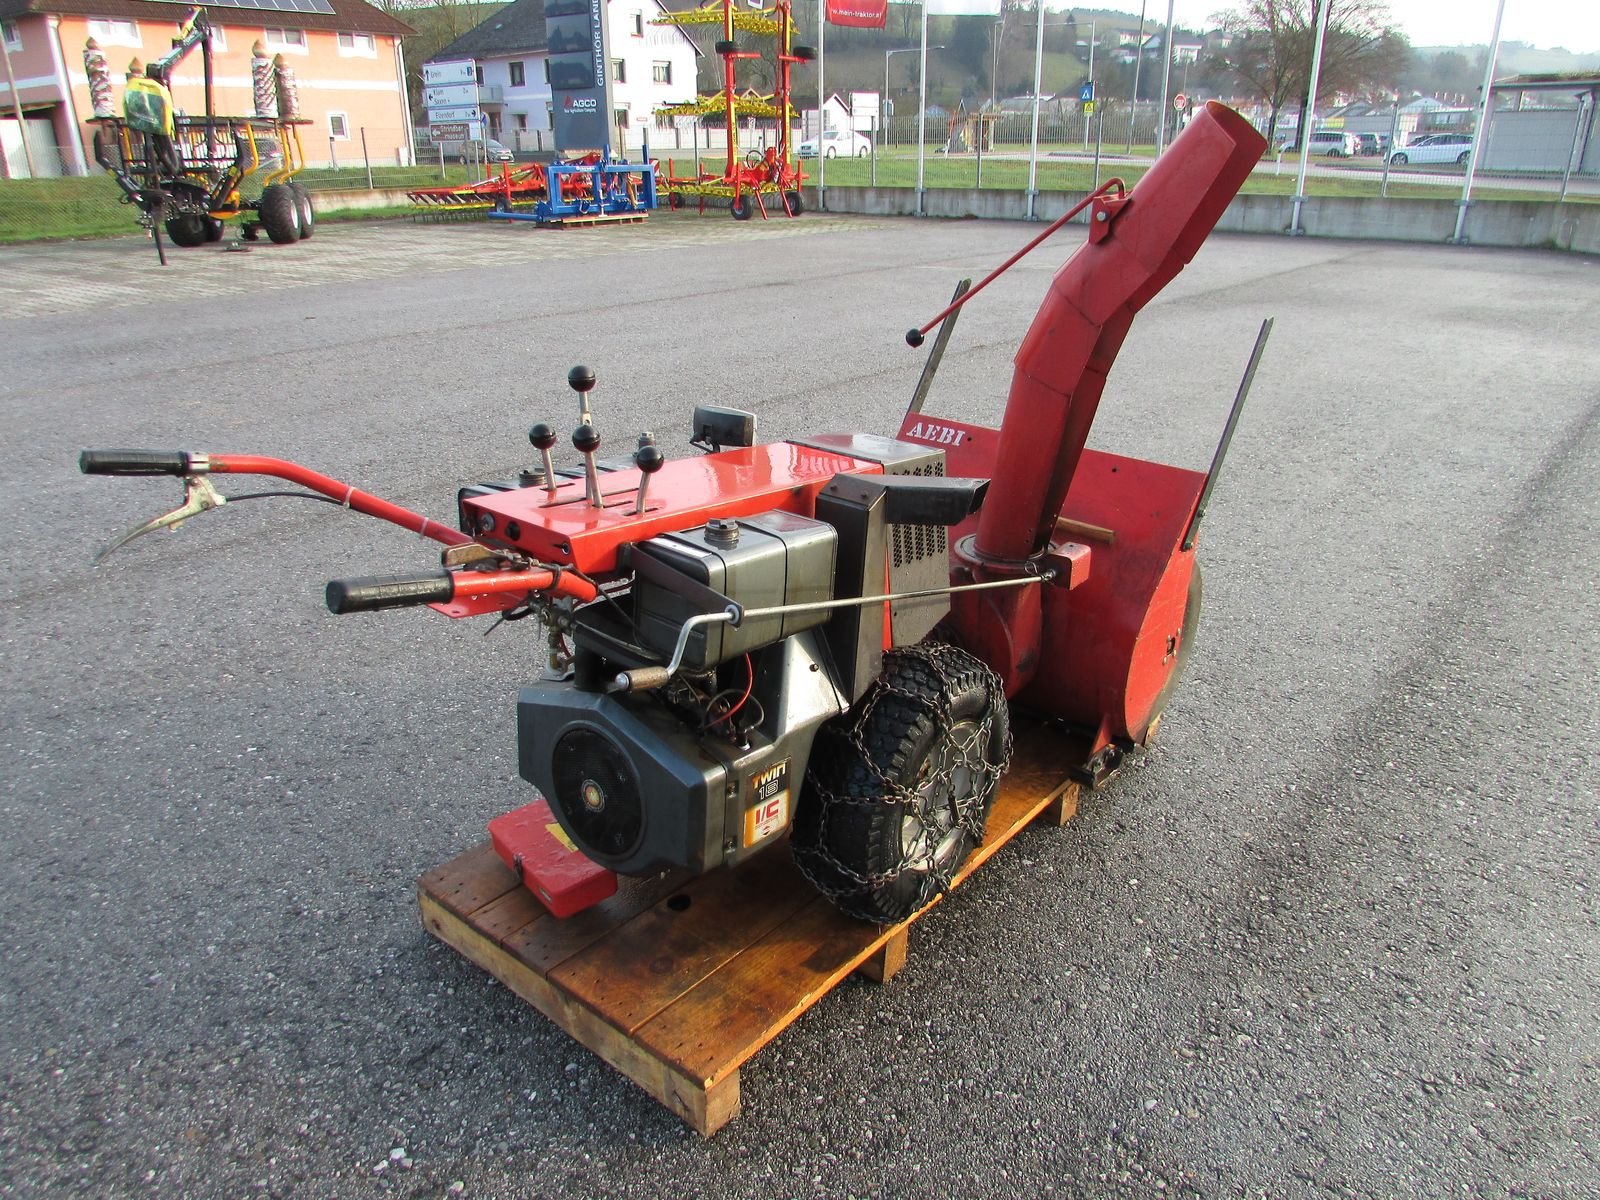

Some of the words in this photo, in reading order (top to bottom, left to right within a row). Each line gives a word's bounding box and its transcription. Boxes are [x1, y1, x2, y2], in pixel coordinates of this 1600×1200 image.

[594, 32, 604, 86] GINTHÖR
[573, 99, 597, 107] AGCO
[905, 422, 966, 446] AEBI
[752, 761, 787, 789] TWIN
[755, 799, 780, 825] I/C
